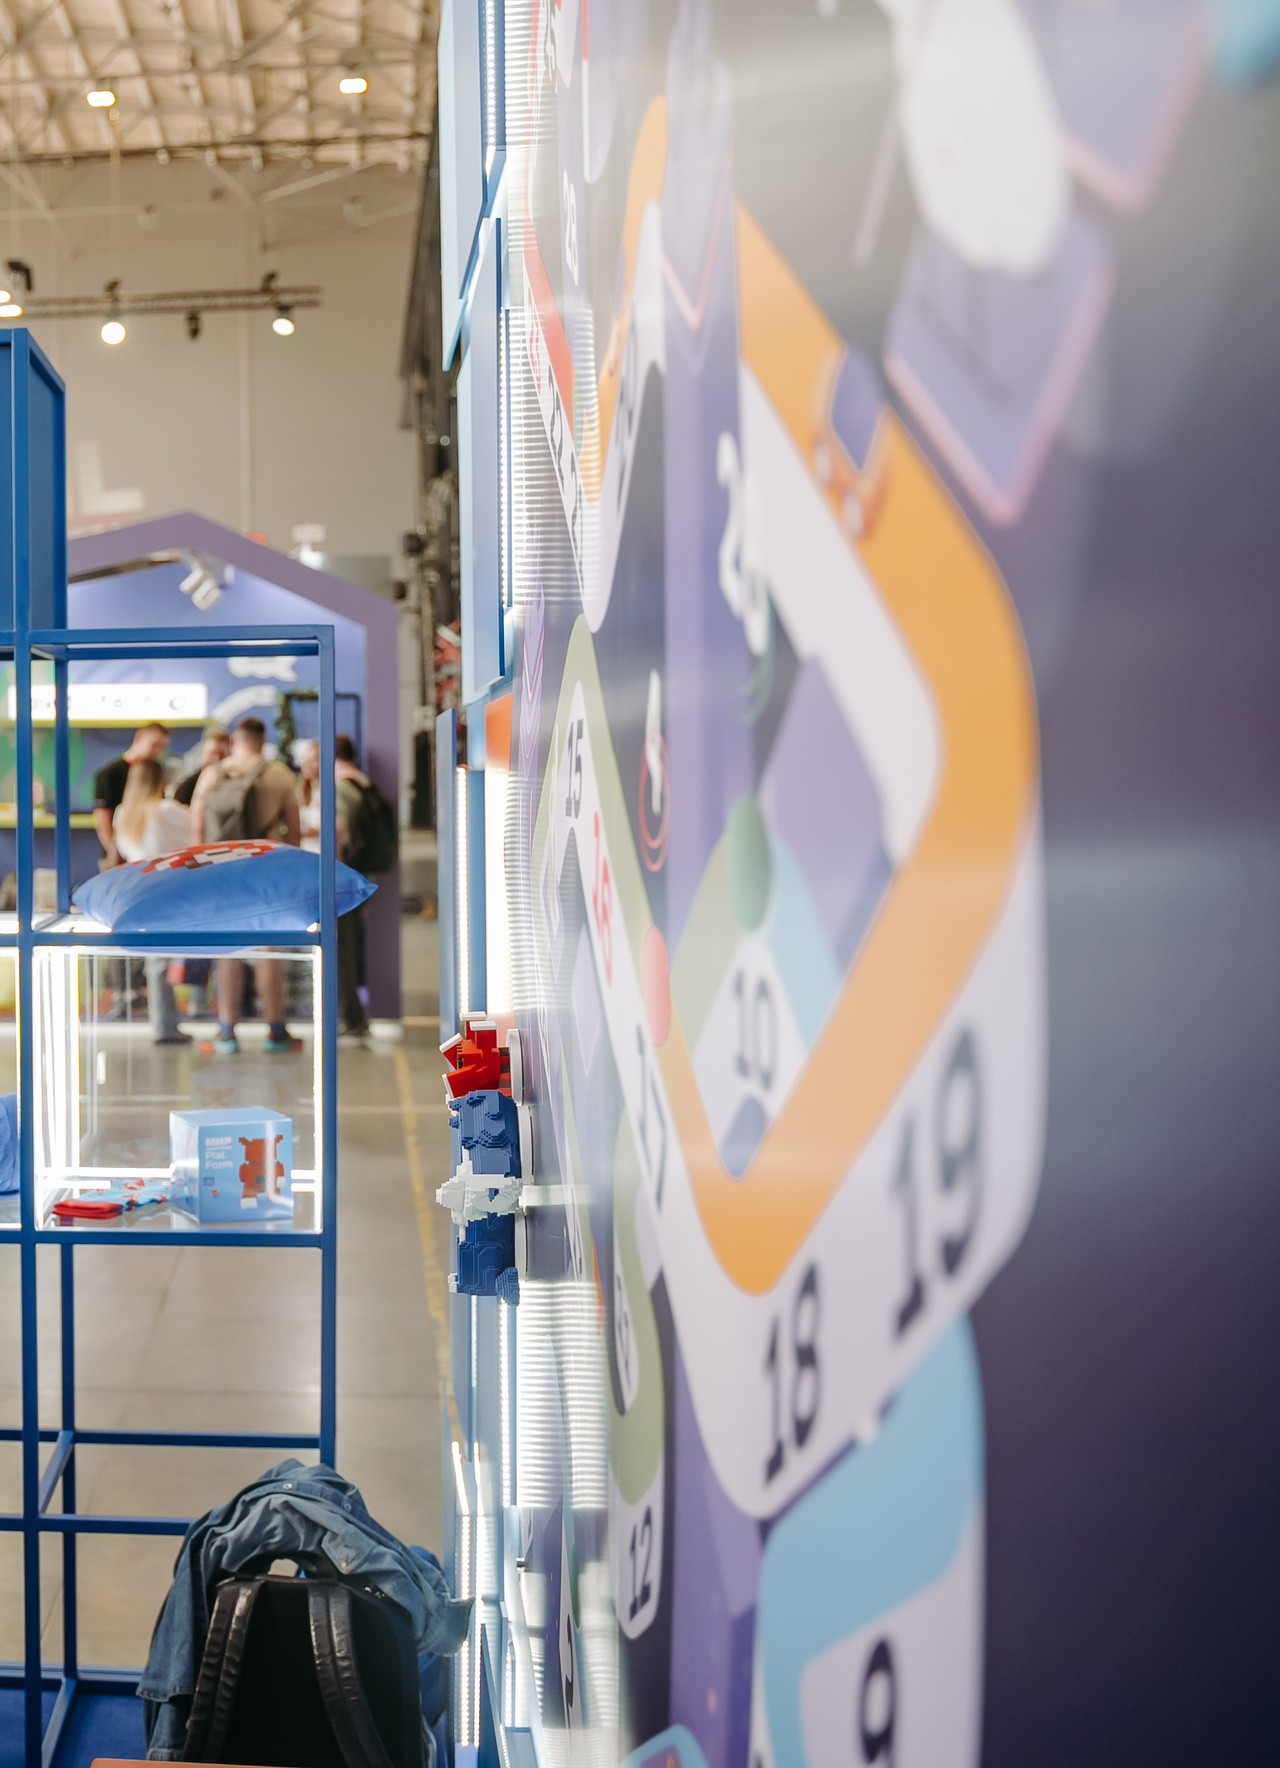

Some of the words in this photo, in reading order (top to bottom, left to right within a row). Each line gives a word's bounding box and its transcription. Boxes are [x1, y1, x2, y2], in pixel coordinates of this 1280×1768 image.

[563, 170, 579, 286] 28
[548, 363, 565, 494] 22
[565, 719, 584, 820] 15
[592, 811, 613, 988] 16
[731, 969, 777, 1093] 10
[893, 1024, 982, 1340] 19
[761, 1260, 820, 1489] 18
[629, 1505, 653, 1623] 12
[856, 1637, 898, 1768] 9
